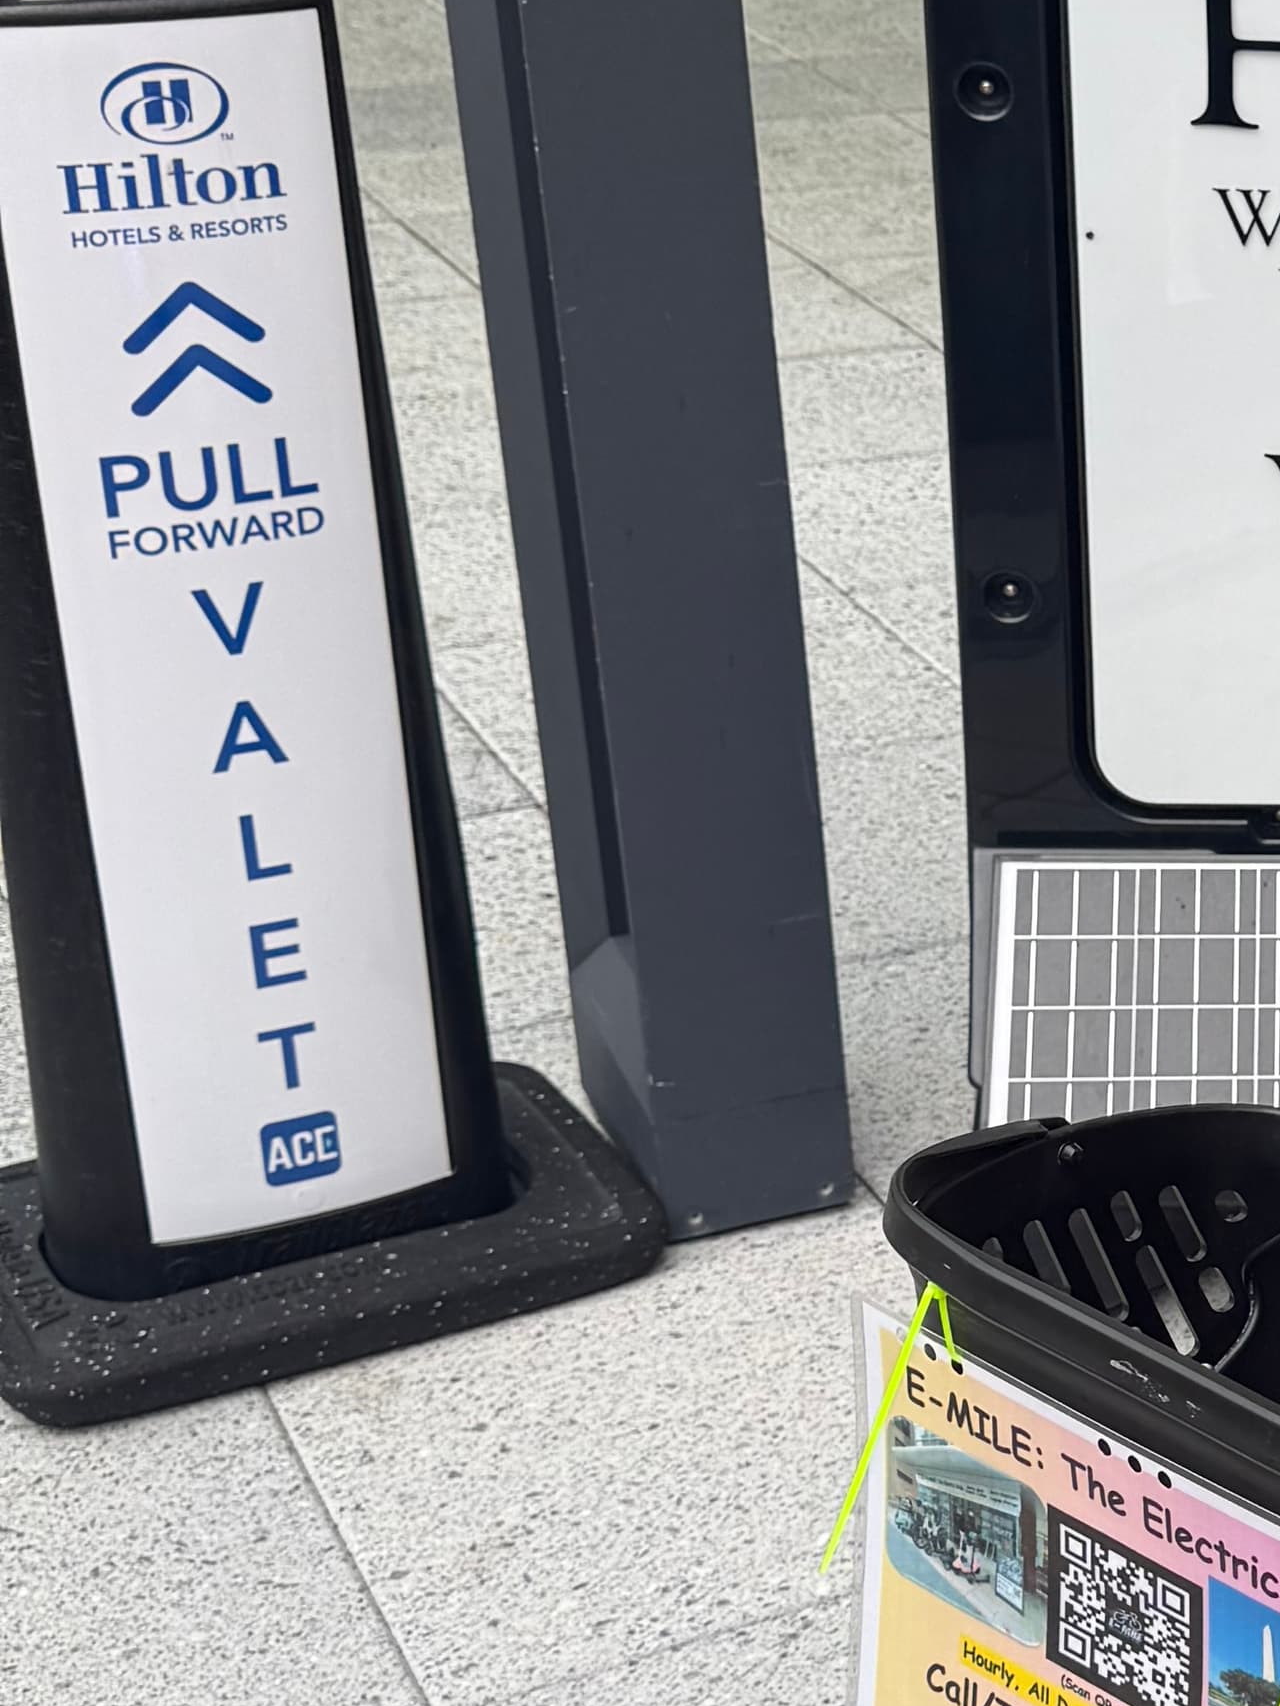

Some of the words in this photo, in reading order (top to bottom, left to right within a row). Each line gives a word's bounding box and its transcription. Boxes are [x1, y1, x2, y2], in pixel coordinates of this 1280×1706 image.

[56, 154, 287, 214] Hilton
[71, 226, 161, 248] HOTELS
[168, 224, 184, 242] &
[191, 214, 288, 241] RESORTS
[99, 437, 319, 518] PULL
[108, 506, 324, 559] FORWARD
[191, 580, 316, 1090] VALET
[267, 1125, 338, 1173] ACE
[906, 1365, 1044, 1470] E-MILE:
[1060, 1452, 1127, 1517] The
[1142, 1495, 1280, 1599] Electric
[1028, 1682, 1050, 1706] All
[1060, 1673, 1091, 1701] (Scan
